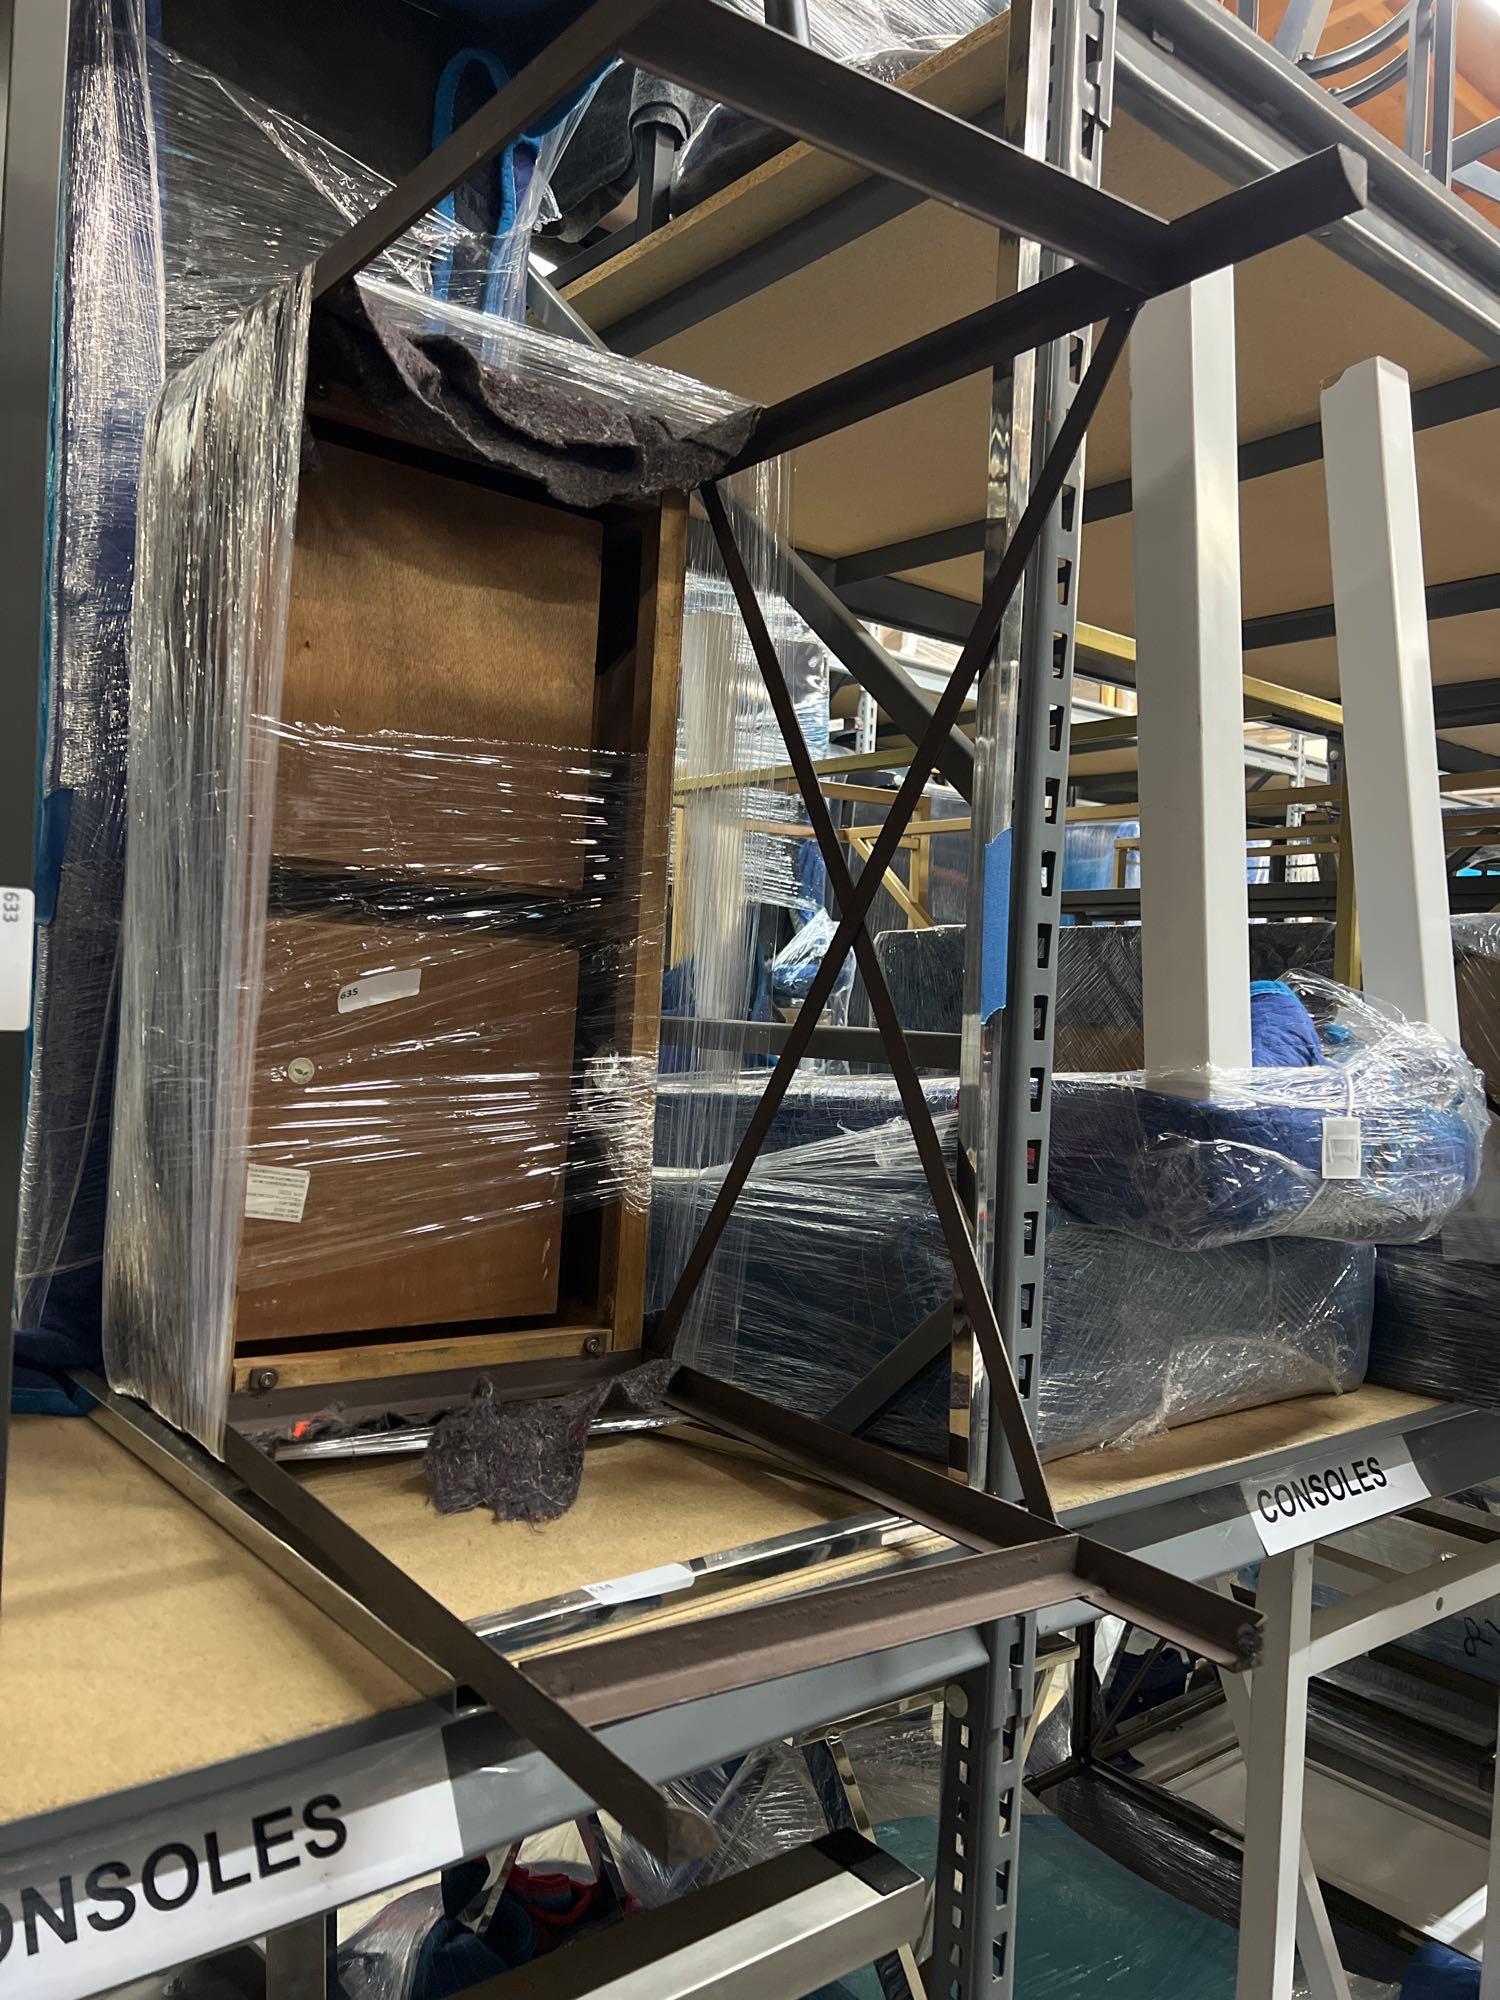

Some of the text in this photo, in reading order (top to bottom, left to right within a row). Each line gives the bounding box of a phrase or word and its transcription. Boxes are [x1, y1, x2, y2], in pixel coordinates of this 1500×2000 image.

[3, 892, 20, 922] 633
[340, 988, 358, 999] 635
[1257, 1457, 1387, 1523] CONSOLES
[0, 1794, 347, 1964] NSOLES
